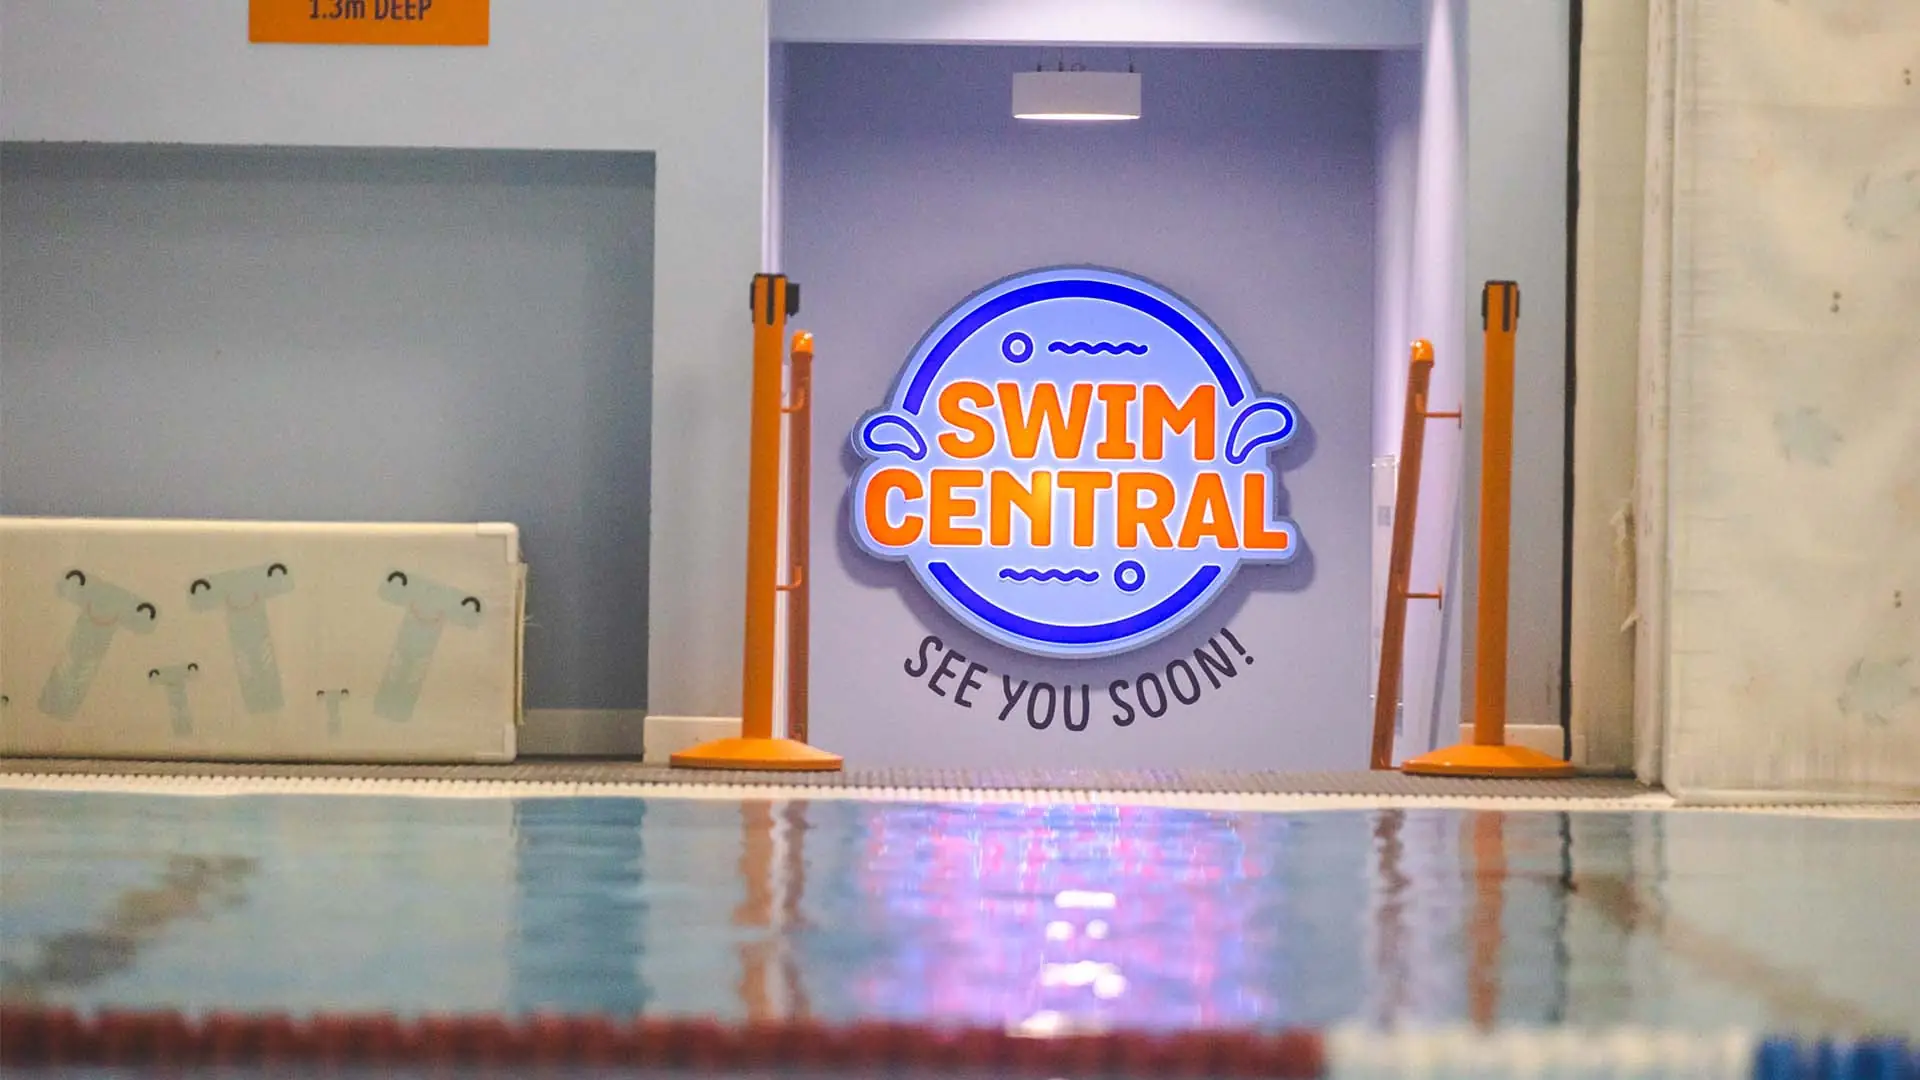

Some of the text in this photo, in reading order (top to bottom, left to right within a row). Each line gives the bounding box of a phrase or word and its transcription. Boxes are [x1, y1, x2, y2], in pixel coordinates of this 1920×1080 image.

[309, 0, 433, 20] 1.3m DEEP
[938, 381, 1216, 461] SWIM
[865, 468, 1288, 549] CENTRAL
[904, 627, 1254, 731] SEE YOU SOON!
